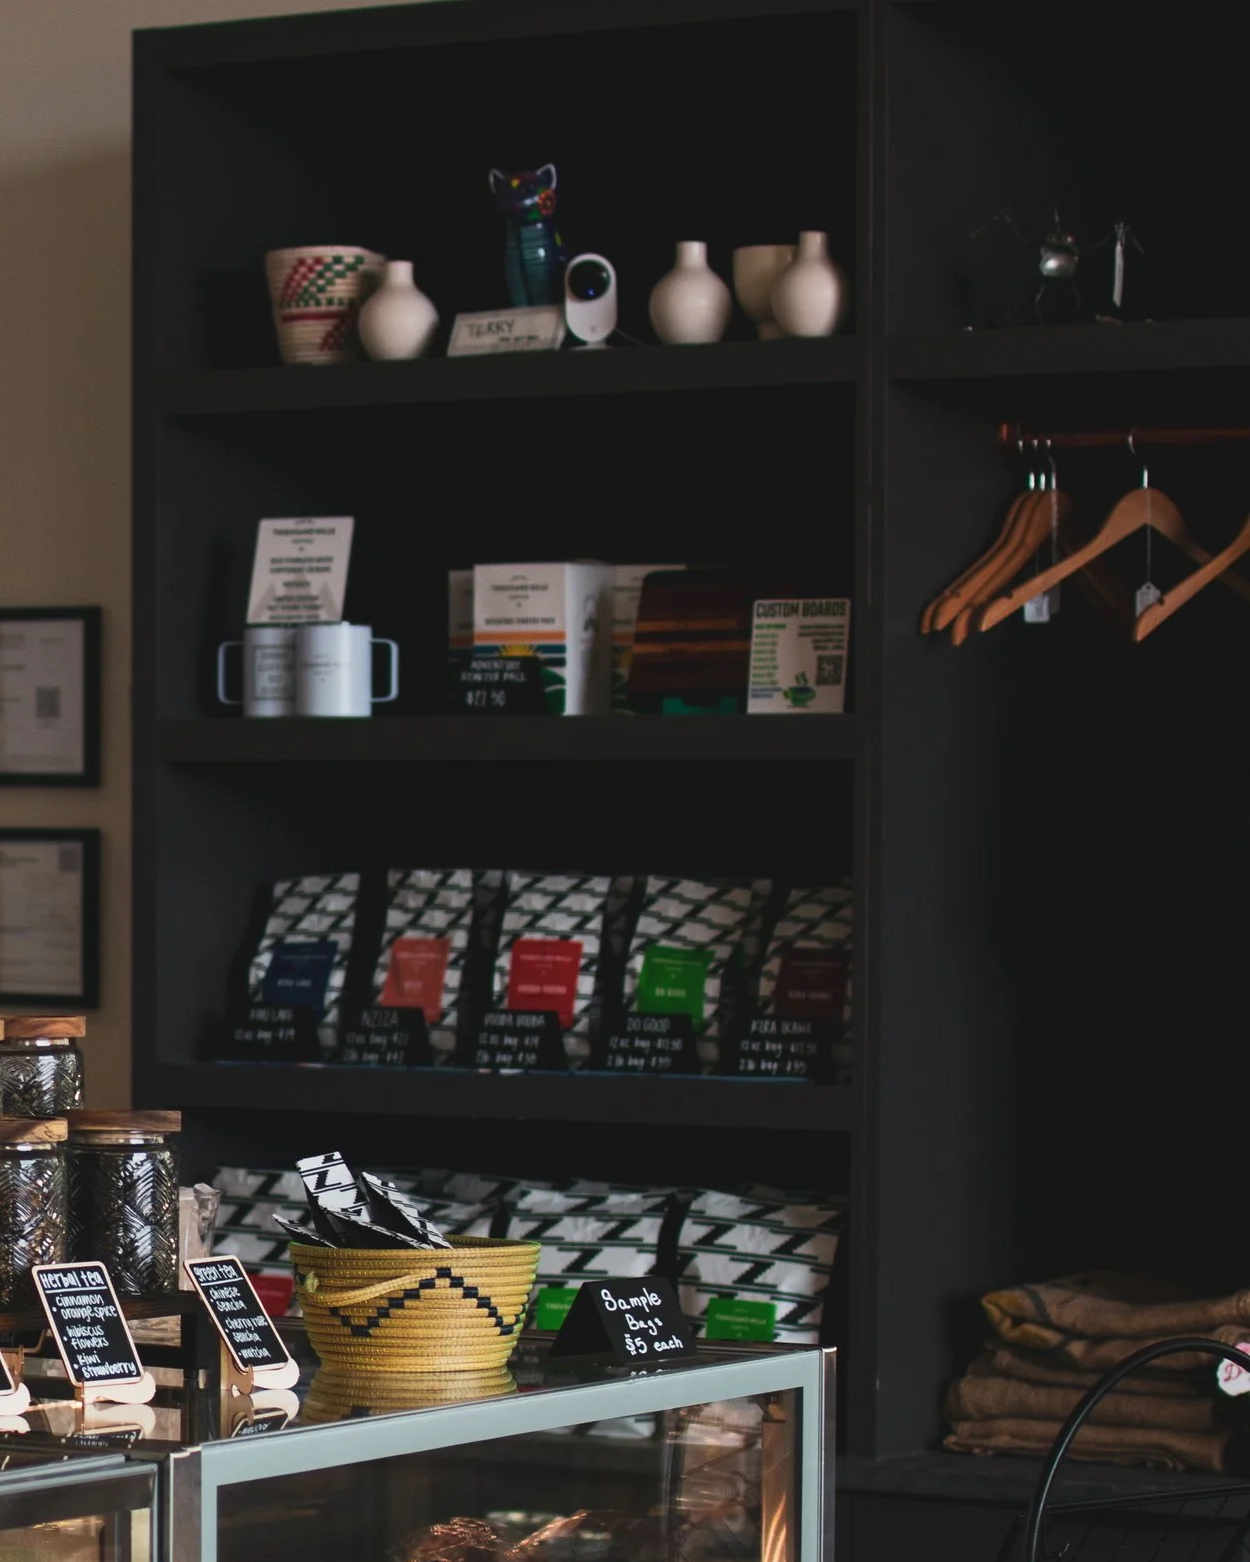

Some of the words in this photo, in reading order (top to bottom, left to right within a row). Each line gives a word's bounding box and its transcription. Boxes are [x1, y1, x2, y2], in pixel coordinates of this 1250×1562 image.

[756, 602, 799, 618] CUSTOM
[802, 601, 847, 617] BOARDS
[39, 1270, 81, 1289] Herbal
[80, 1270, 105, 1288] tea
[193, 1264, 222, 1282] green
[217, 1263, 239, 1279] tea
[55, 1294, 105, 1308] cinnamon
[210, 1286, 241, 1300] chinese
[601, 1288, 661, 1313] Sample
[61, 1306, 95, 1322] orange
[93, 1305, 118, 1322] spice
[66, 1324, 105, 1338] hibiscus
[225, 1316, 256, 1331] cherry
[253, 1315, 268, 1327] rose
[625, 1313, 663, 1335] Bags
[240, 1346, 271, 1359] matcha
[625, 1333, 647, 1356] $5
[653, 1335, 684, 1352] each
[81, 1361, 137, 1379] strawberry
